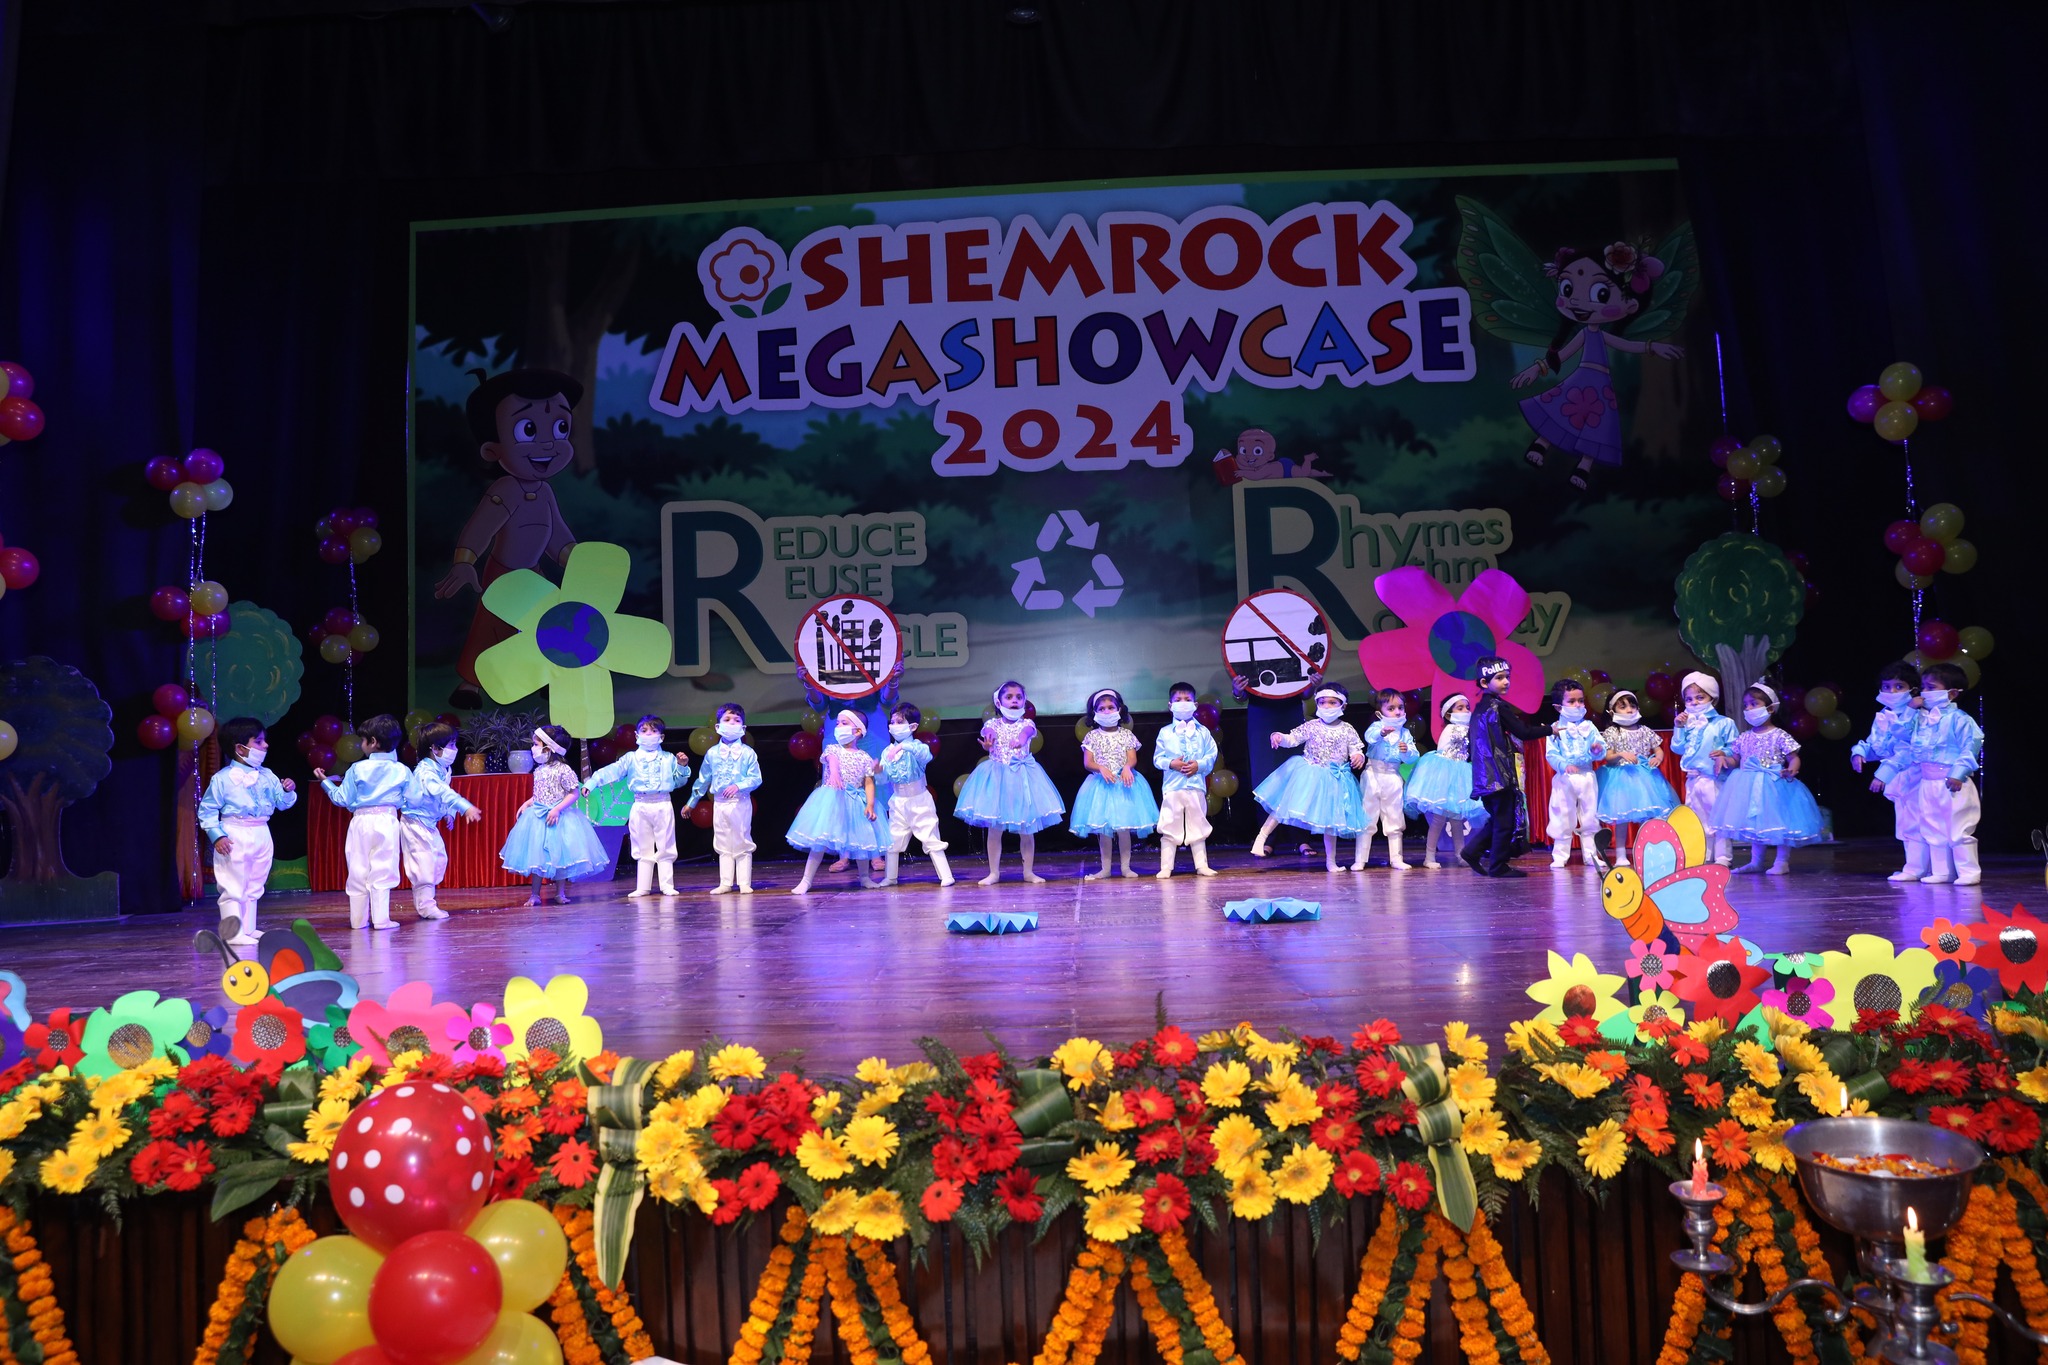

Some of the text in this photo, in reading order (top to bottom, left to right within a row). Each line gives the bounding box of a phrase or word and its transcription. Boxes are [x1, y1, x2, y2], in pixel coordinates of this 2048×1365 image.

[802, 213, 1404, 310] SHEMROCK
[660, 298, 1465, 406] MEGASHOWCASE
[945, 401, 1181, 465] 2024
